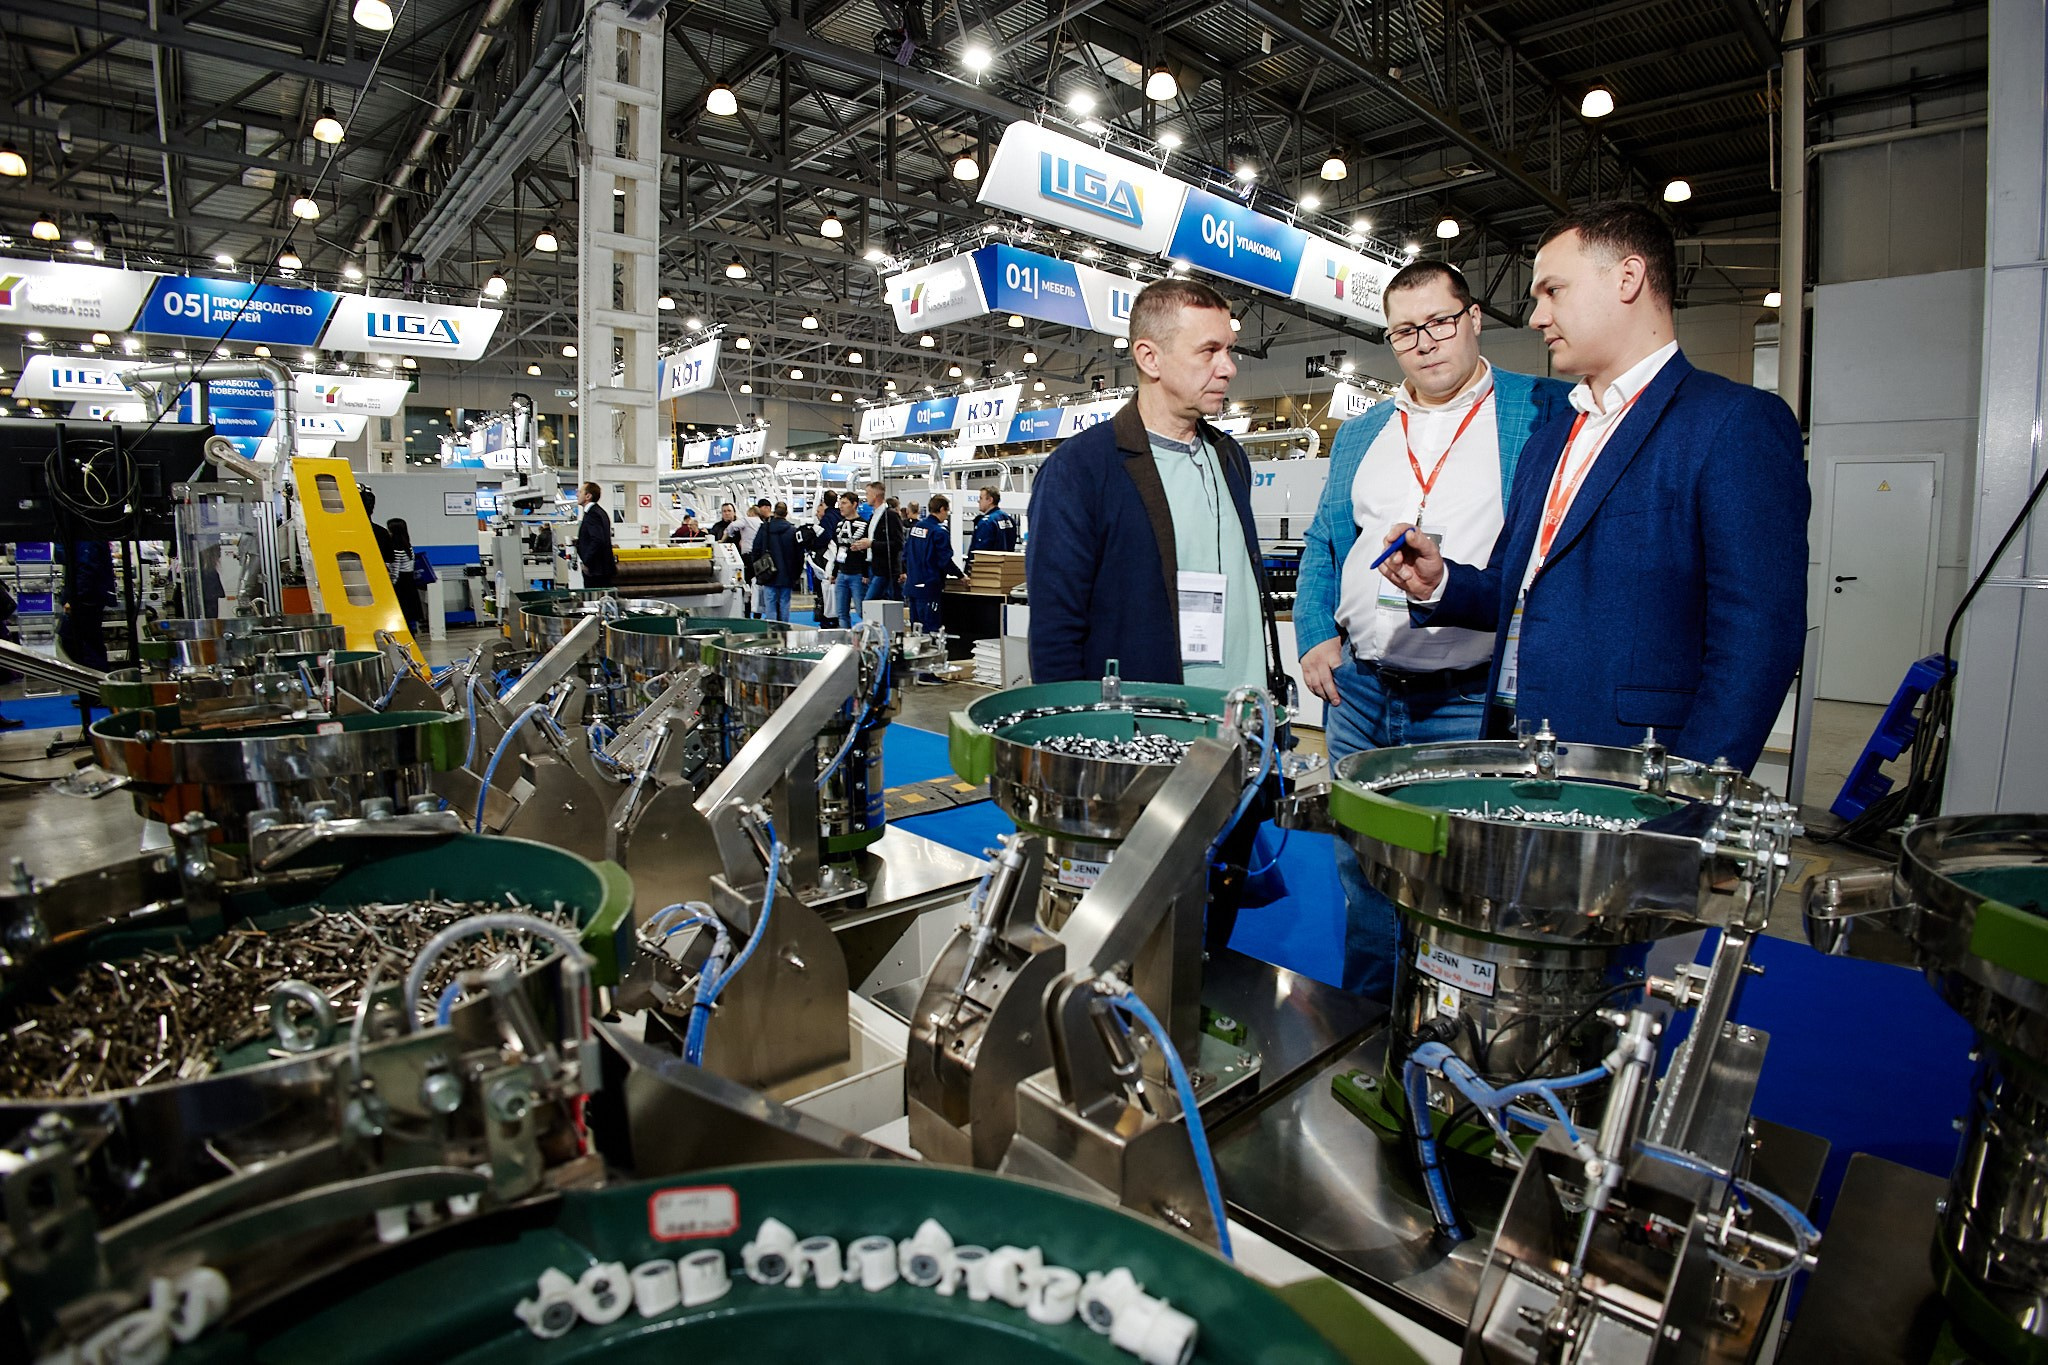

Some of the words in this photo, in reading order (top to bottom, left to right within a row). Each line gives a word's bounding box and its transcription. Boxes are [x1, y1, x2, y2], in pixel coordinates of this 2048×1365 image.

[1039, 151, 1144, 228] LIGA
[1236, 236, 1282, 263] УПАКОВКА
[1041, 280, 1076, 298] МЕБЕЛЬ
[212, 296, 313, 316] ПРОИЗВОДСТВО
[212, 310, 262, 324] ДВЕРЕЙ
[367, 312, 460, 344] LIGA
[209, 380, 260, 388] ОБРАБОТКА
[209, 387, 275, 398] ПОВЕРХНОСТЕЙ
[1073, 864, 1100, 876] JENN
[1432, 950, 1459, 968] JENN
[1472, 964, 1492, 978] TAI
